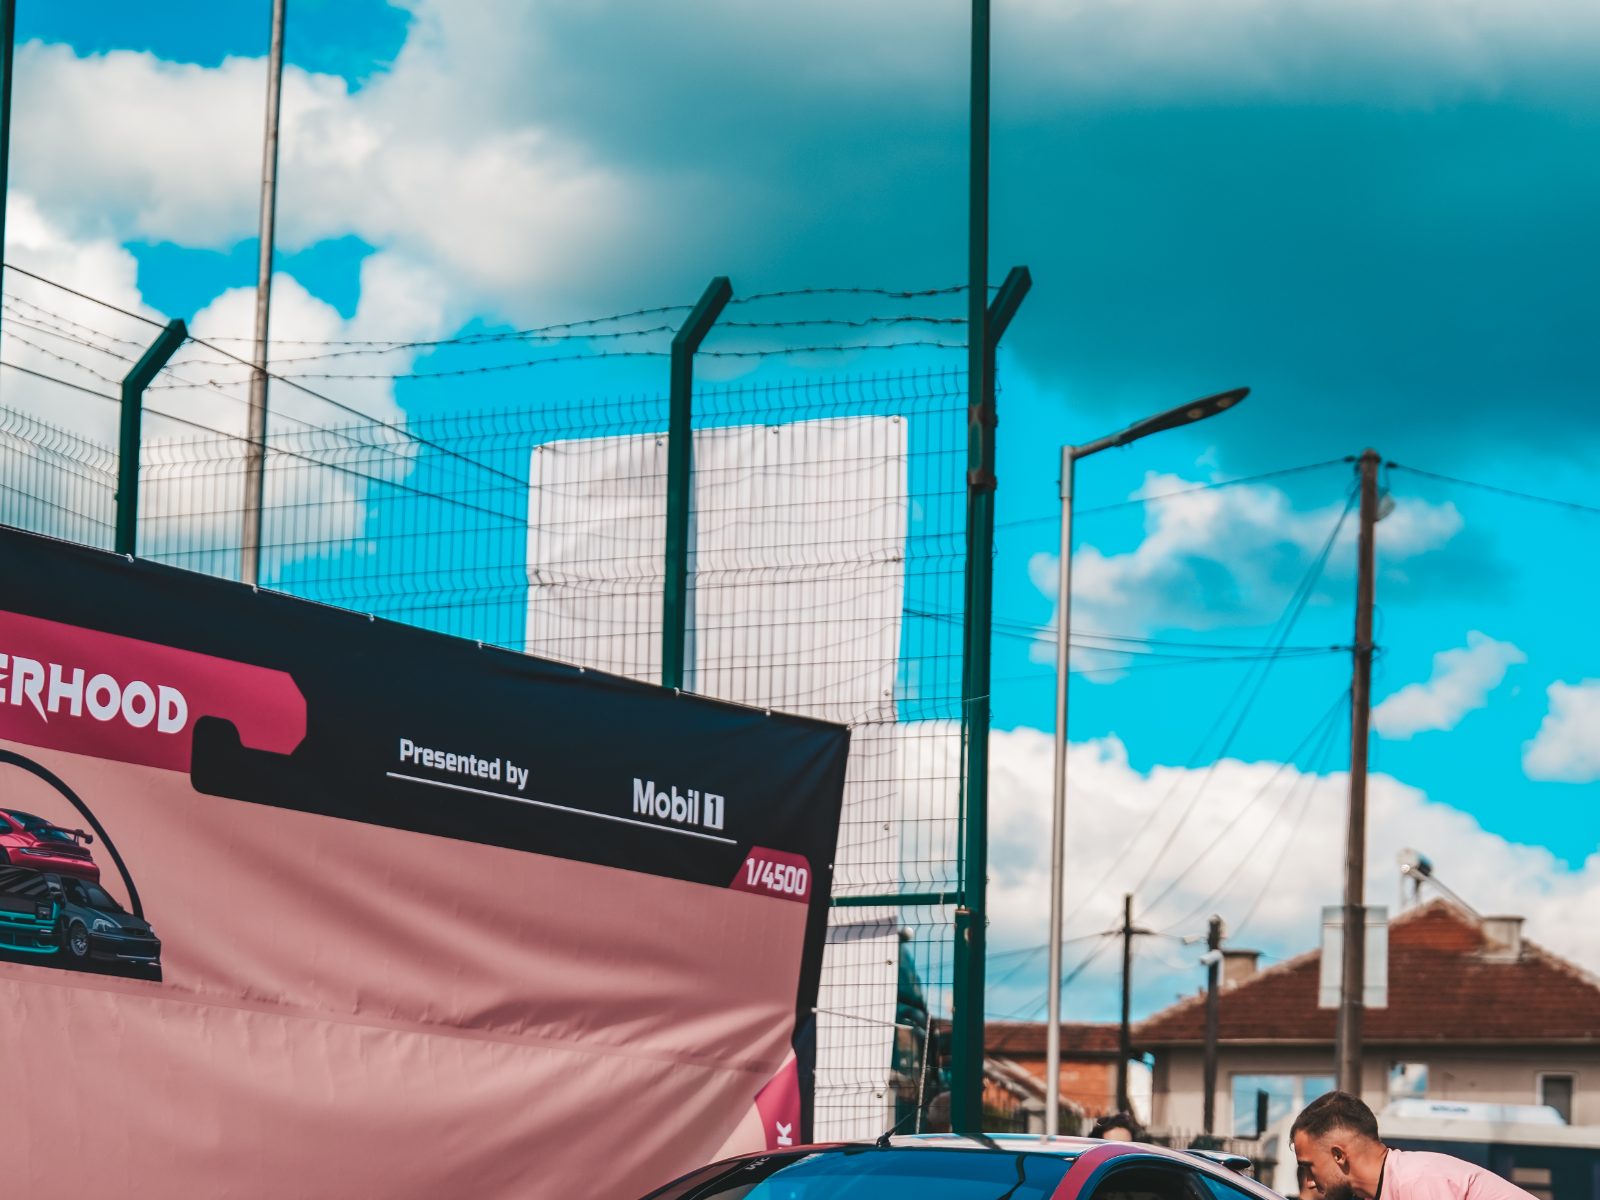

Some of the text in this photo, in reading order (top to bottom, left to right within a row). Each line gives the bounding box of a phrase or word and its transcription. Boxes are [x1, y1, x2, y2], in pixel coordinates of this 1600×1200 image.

[400, 738, 528, 790] Presented by
[633, 778, 699, 825] Mobil
[746, 858, 808, 896] 1/4500
